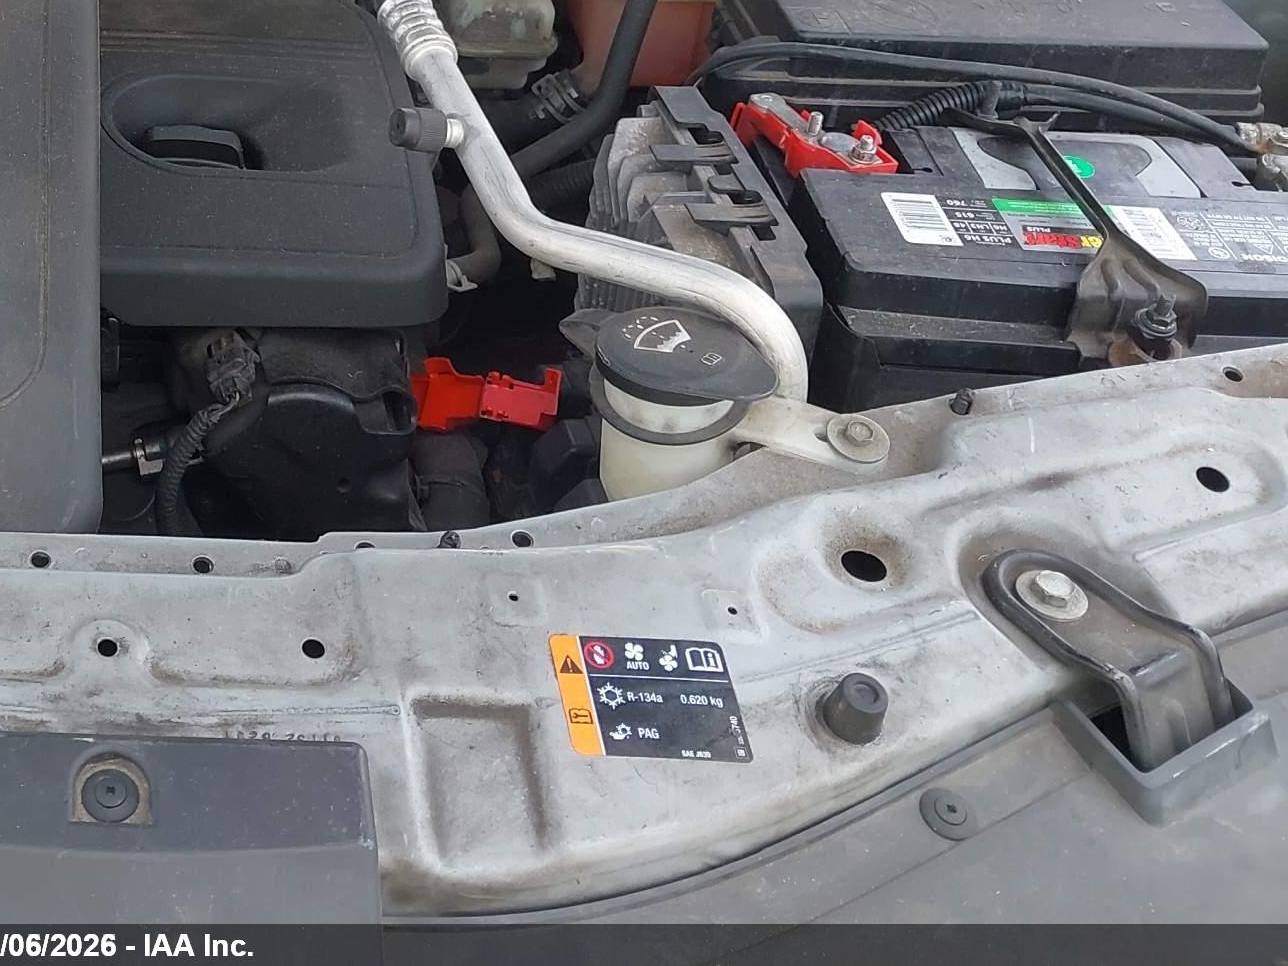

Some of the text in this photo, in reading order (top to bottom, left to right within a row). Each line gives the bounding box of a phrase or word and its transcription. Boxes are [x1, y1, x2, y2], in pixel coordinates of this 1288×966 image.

[982, 235, 1013, 244] PLUS
[626, 661, 649, 671] AUTO
[627, 692, 724, 708] R-134a 0.620 kg
[638, 727, 660, 739] PAG
[681, 749, 695, 757] SAE
